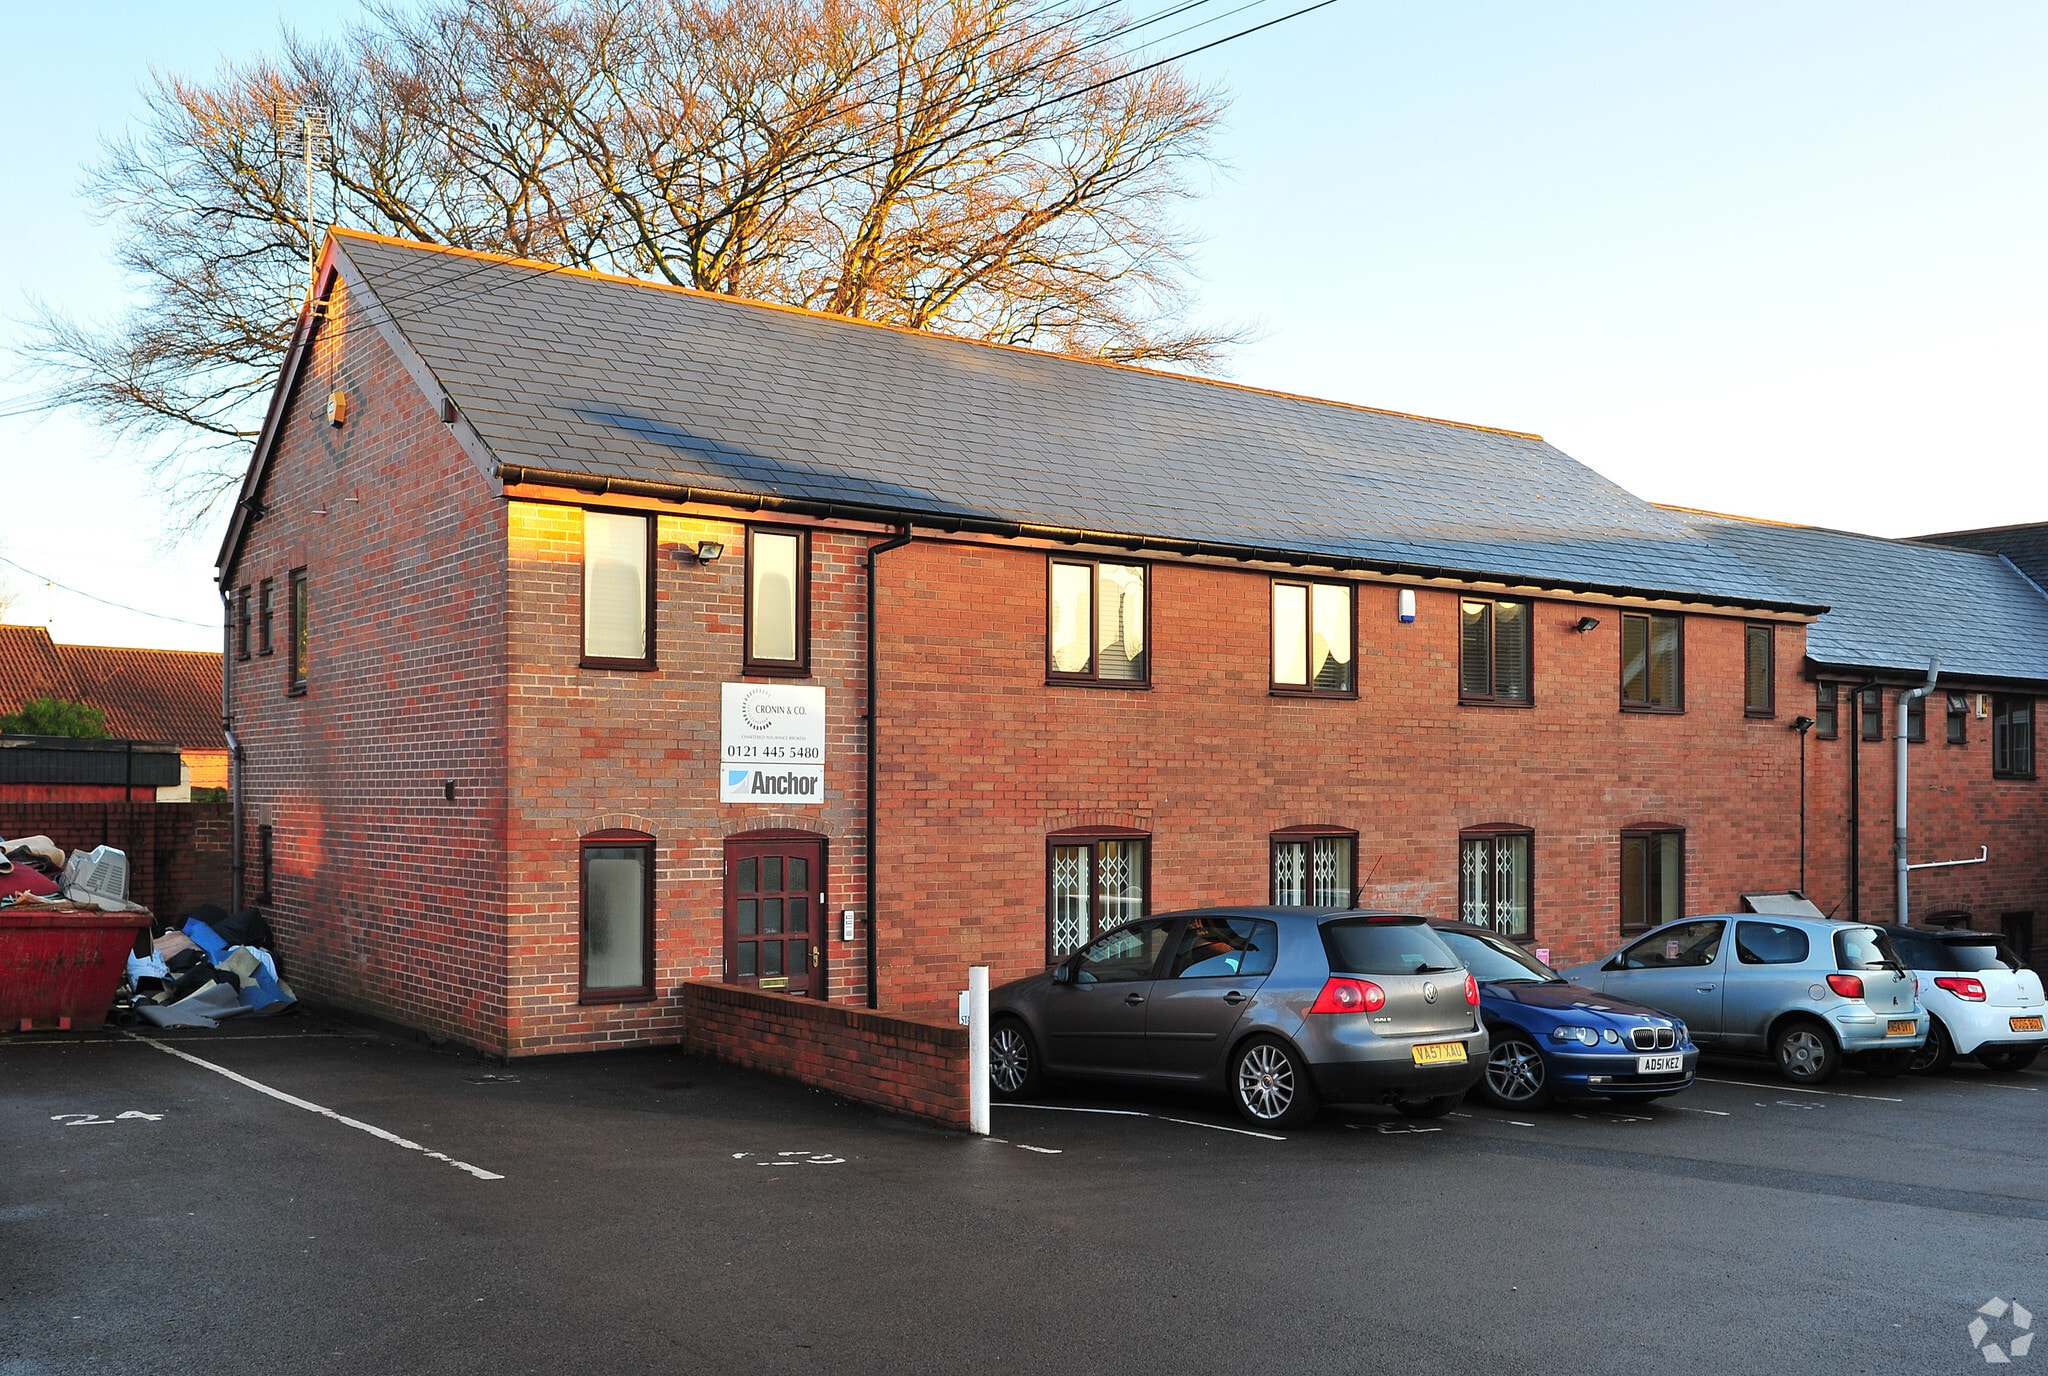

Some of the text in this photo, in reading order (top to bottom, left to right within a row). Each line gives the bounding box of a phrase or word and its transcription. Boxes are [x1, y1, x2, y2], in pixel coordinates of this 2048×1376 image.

[755, 704, 807, 716] CRONIN & CO.
[727, 745, 819, 759] 0121 445 5480
[751, 770, 818, 795] Anchor
[1445, 1044, 1462, 1057] XAU
[1645, 1057, 1679, 1071] AD51 KEZ
